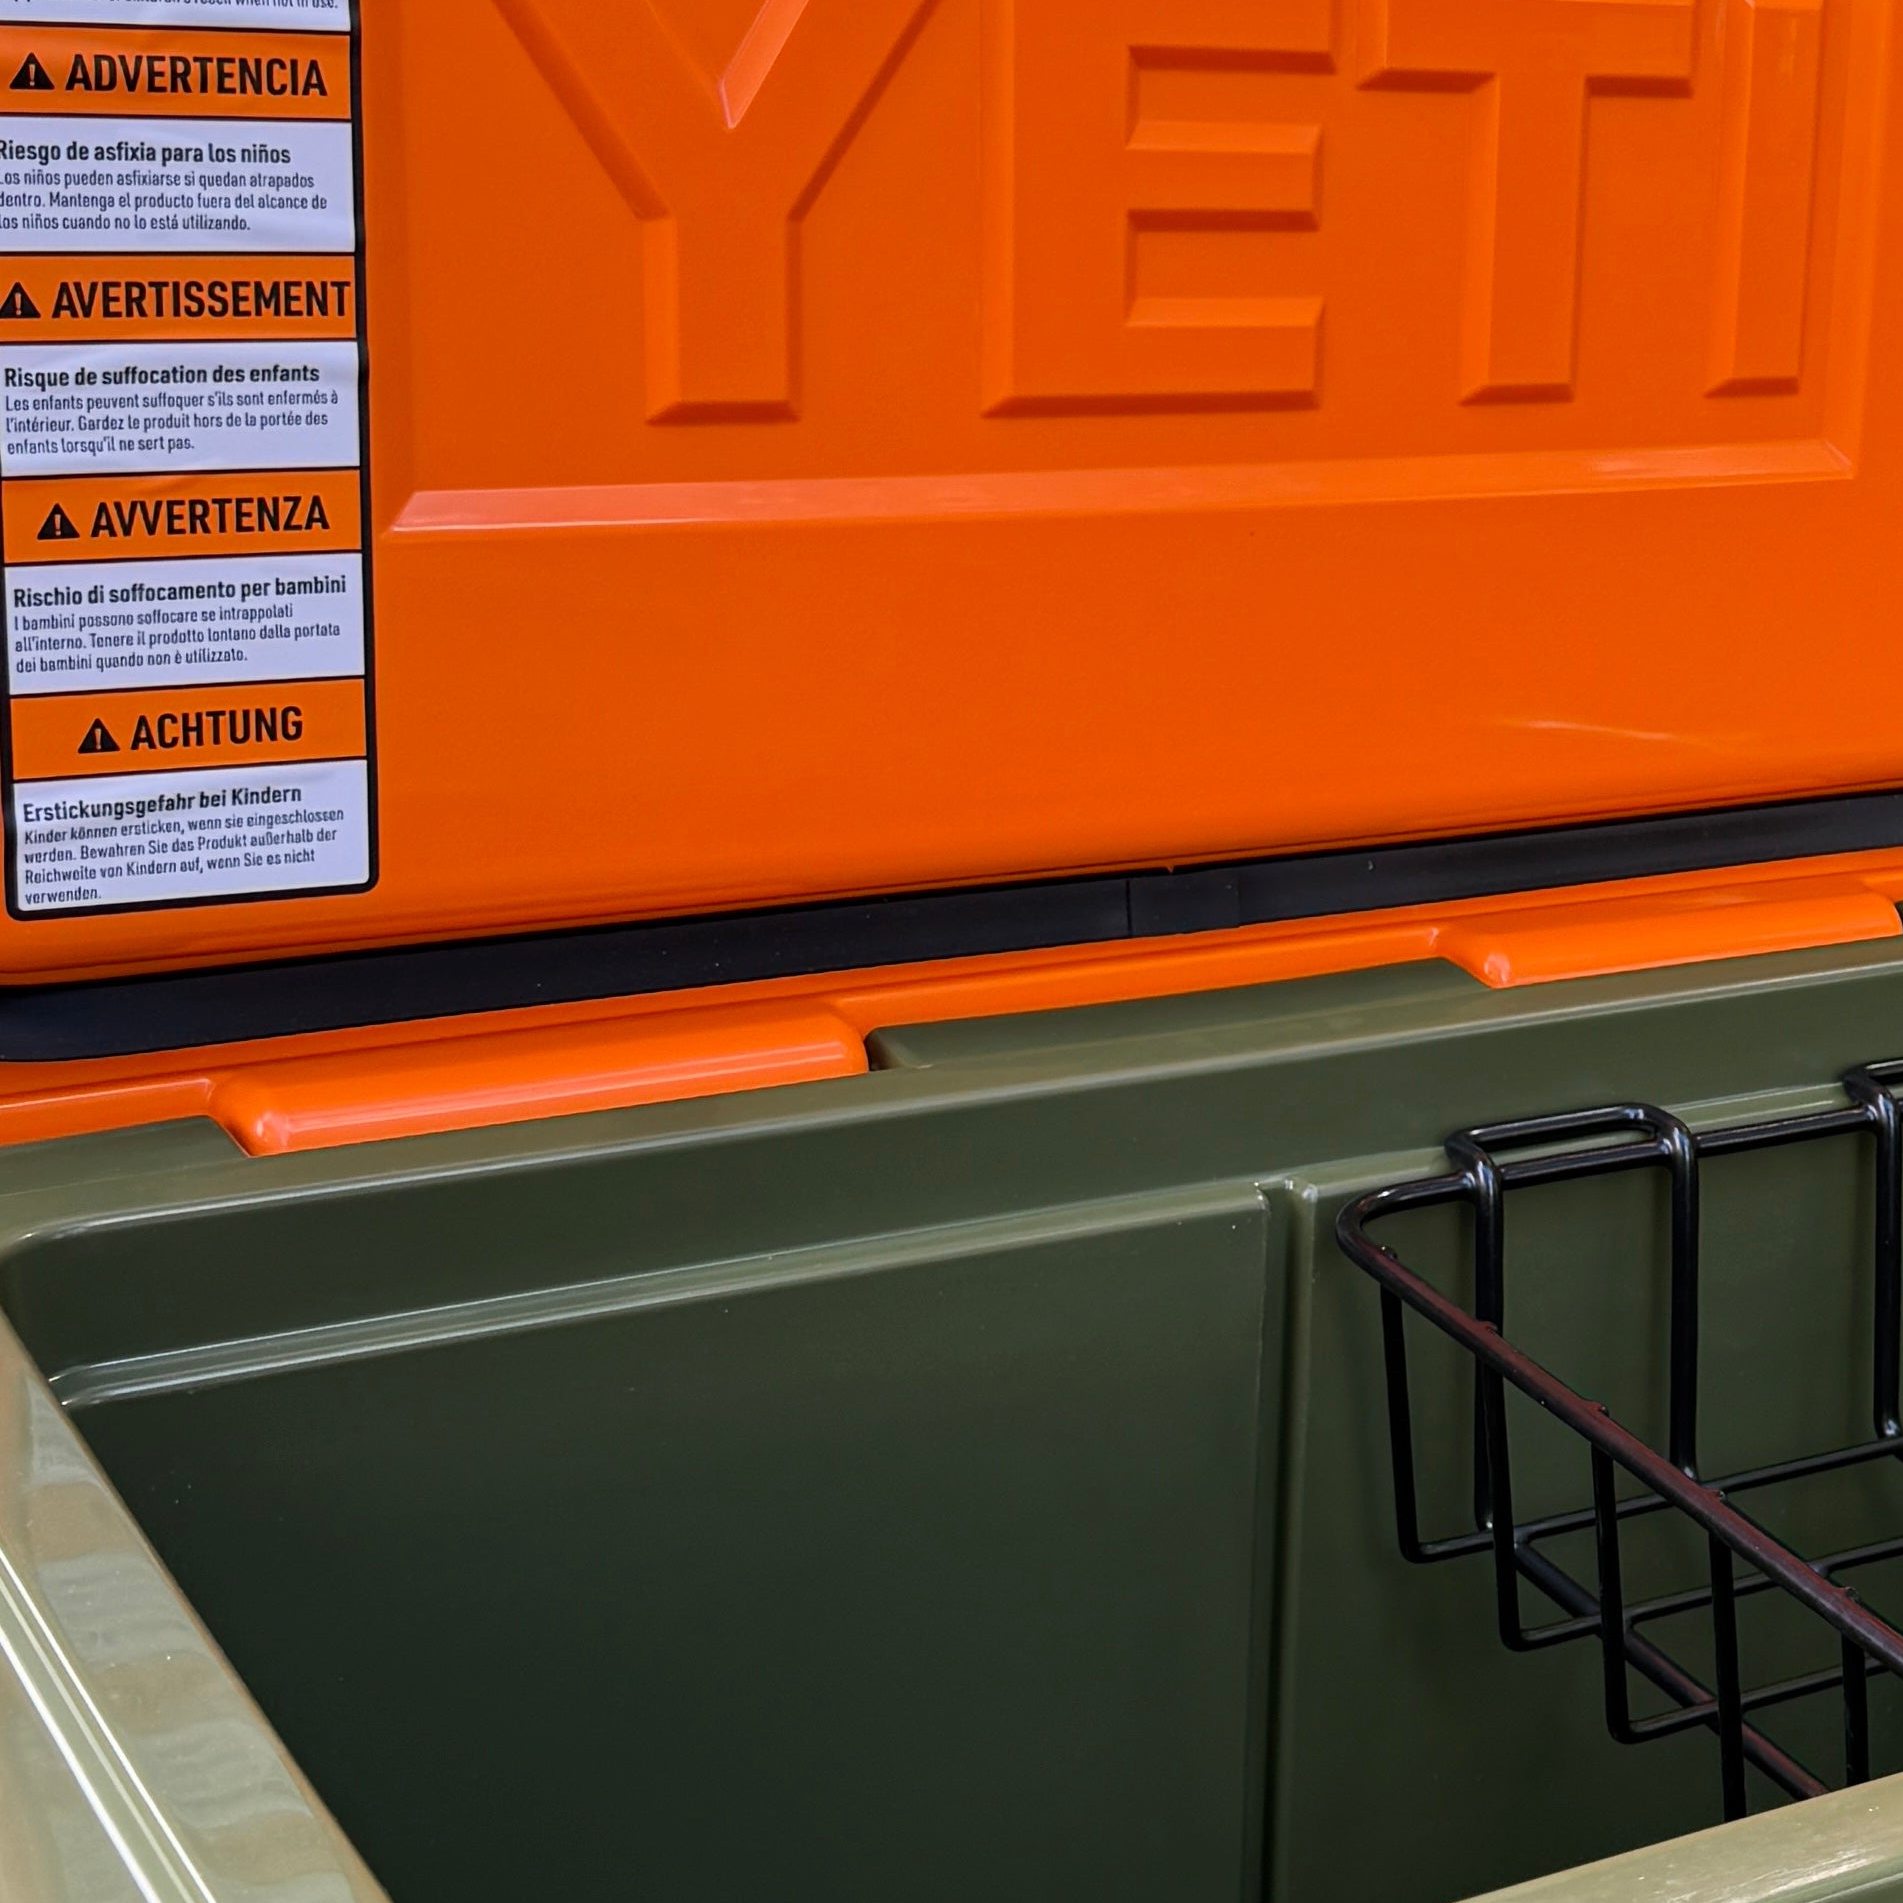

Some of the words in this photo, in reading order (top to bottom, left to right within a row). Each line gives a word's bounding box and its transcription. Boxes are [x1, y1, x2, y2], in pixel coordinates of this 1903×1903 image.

[65, 54, 328, 96] ADVERTENCIA
[0, 140, 61, 165] Riesgo
[67, 141, 89, 161] de
[94, 142, 156, 161] asfixia
[162, 147, 203, 167] para
[208, 143, 236, 163] los
[241, 143, 291, 163] niños
[24, 169, 60, 185] niños
[64, 170, 113, 189] pueden
[117, 170, 181, 186] asfixiarse
[184, 171, 195, 186] si
[199, 171, 246, 190] quedan
[250, 172, 314, 191] atrapados
[50, 192, 115, 212] Mantenga
[119, 192, 131, 208] el
[135, 193, 193, 211] producto
[198, 193, 231, 208] fuera
[235, 194, 254, 208] del
[258, 194, 308, 209] alcance
[312, 195, 327, 209] de
[23, 213, 58, 229] niños
[63, 214, 110, 230] cuando
[115, 217, 130, 230] no
[134, 214, 146, 230] lo
[151, 214, 178, 230] está
[182, 214, 250, 230] utilizando.
[52, 281, 351, 319] AVERTISSEMENT
[5, 368, 69, 392] Risque
[75, 367, 97, 385] de
[102, 365, 207, 385] suffocation
[212, 365, 245, 383] des
[250, 364, 319, 382] enfants
[6, 395, 29, 412] Les
[33, 395, 83, 411] enfants
[87, 394, 139, 413] peuvent
[143, 392, 204, 410] suffoquer
[237, 391, 264, 406] sont
[268, 390, 328, 405] enfermés
[331, 390, 338, 405] à
[78, 415, 124, 431] Gardez
[128, 414, 140, 429] le
[144, 413, 189, 433] produit
[194, 413, 222, 428] hors
[226, 413, 241, 427] de
[245, 412, 256, 426] la
[260, 411, 301, 430] portée
[305, 411, 328, 425] des
[7, 439, 58, 455] enfants
[120, 440, 134, 451] ne
[138, 436, 164, 451] sert
[168, 438, 195, 454] pas.
[91, 495, 330, 539] AVVERTENZA
[14, 586, 82, 607] Rischio
[88, 585, 104, 604] di
[109, 581, 235, 603] soffocamento
[241, 582, 271, 602] per
[275, 575, 346, 596] bambini
[23, 613, 75, 630] bambini
[79, 614, 133, 632] possono
[137, 609, 197, 625] soffocare
[201, 610, 216, 622] se
[220, 603, 293, 623] intrappolati
[90, 633, 133, 648] Tenere
[137, 631, 145, 646] il
[149, 629, 204, 649] prodotto
[208, 628, 256, 642] lontano
[260, 624, 290, 639] dalla
[295, 623, 340, 641] portata
[17, 657, 36, 673] dei
[41, 654, 92, 672] bambini
[96, 652, 143, 672] quando
[147, 654, 170, 666] non
[174, 649, 182, 664] è
[186, 648, 248, 663] utilizzato.
[130, 706, 303, 750] ACHTUNG
[23, 793, 195, 822] Erstickungsgefahr
[199, 789, 226, 808] bei
[232, 786, 301, 806] Kindern
[25, 829, 67, 844] Kinder
[71, 826, 117, 840] können
[121, 820, 184, 836] ersticken,
[188, 817, 221, 831] wenn
[225, 814, 243, 828] sie
[247, 809, 344, 829] eingeschlossen
[24, 848, 76, 864] werden.
[81, 844, 145, 860] Bewahren
[149, 840, 168, 854] Sie
[172, 838, 194, 852] das
[198, 834, 247, 850] Produkt
[250, 828, 313, 847] außerhalb
[317, 827, 337, 842] der
[26, 865, 96, 884] Reichweite
[101, 866, 123, 878] von
[127, 860, 176, 876] Kindern
[180, 856, 203, 874] auf,
[207, 856, 240, 870] wenn
[244, 853, 262, 867] Sie
[267, 854, 281, 864] es
[284, 849, 315, 864] nicht
[25, 887, 101, 905] verwenden.
